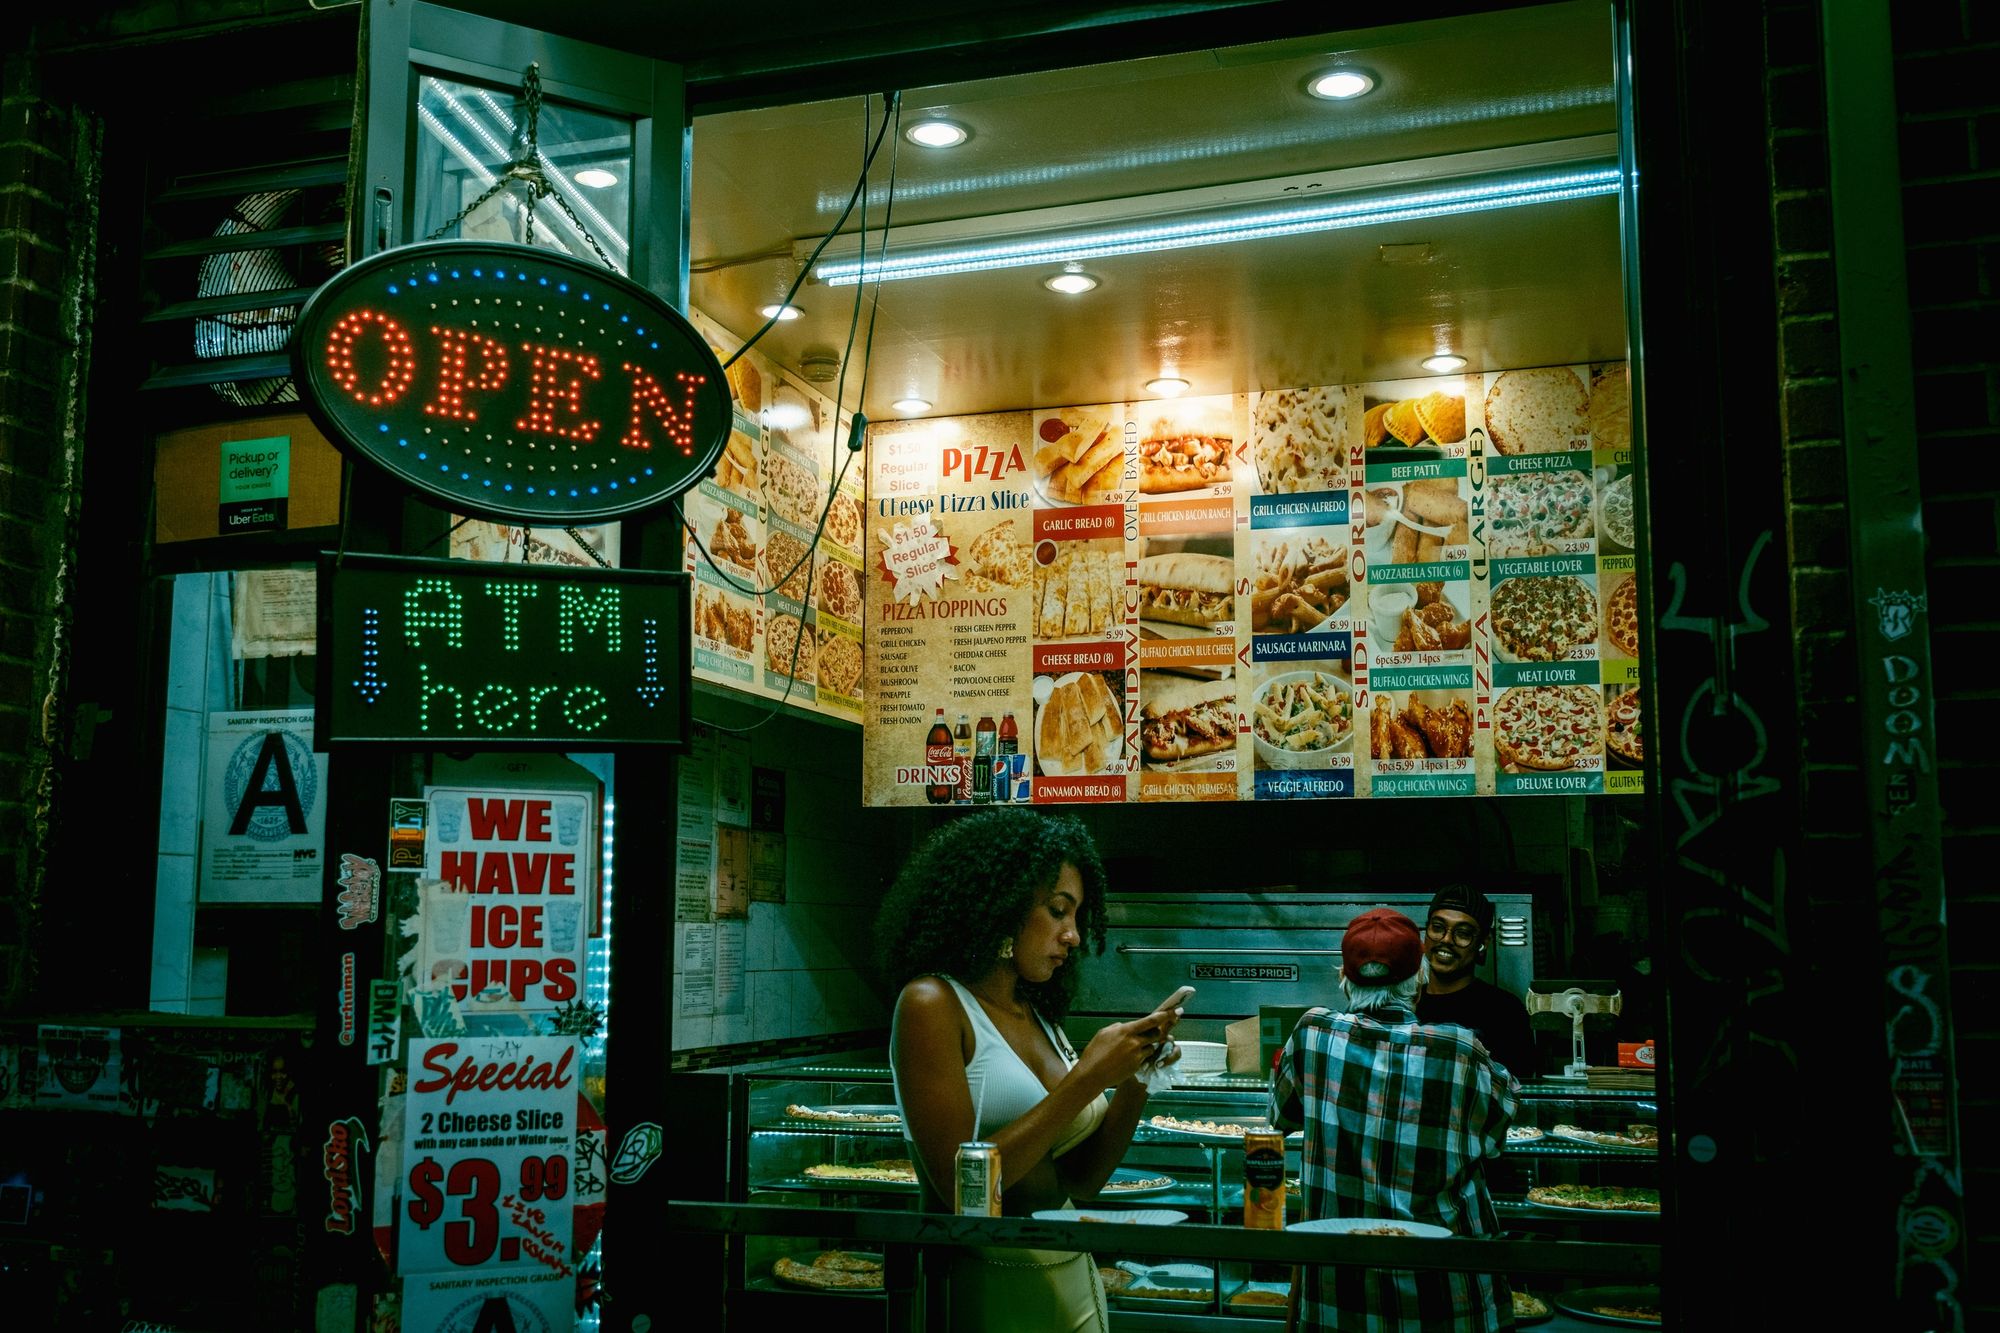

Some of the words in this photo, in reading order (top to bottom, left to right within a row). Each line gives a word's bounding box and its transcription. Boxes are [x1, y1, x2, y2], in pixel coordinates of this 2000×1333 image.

[326, 309, 706, 456] OPEN
[1125, 421, 1137, 480] BAKED
[1448, 448, 1464, 457] 1.99
[230, 451, 265, 466] Pickup
[268, 451, 280, 461] or
[1509, 457, 1543, 470] CHEESE
[1545, 456, 1573, 467] PIZZA
[230, 464, 278, 480] delivery?
[881, 463, 928, 476] Regular
[1392, 466, 1411, 478] BEEF
[1414, 464, 1441, 476] PATTY
[890, 480, 920, 491] Slice
[1327, 478, 1346, 488] 6.99
[1105, 493, 1123, 502] 4.99
[1214, 486, 1231, 496] 5.99
[940, 493, 985, 513] Pizza
[991, 490, 1029, 510] Slice
[1253, 504, 1274, 516] GRILL
[1276, 503, 1309, 515] CHICKEN
[1311, 500, 1346, 513] ALFREDO
[229, 515, 250, 525] Uber
[252, 513, 274, 523] Eats
[1125, 490, 1138, 542] OVEN
[1140, 510, 1156, 523] GRILL
[1157, 509, 1184, 521] CHICKEN
[1185, 508, 1208, 520] BACON
[1209, 507, 1231, 519] RANCH
[1351, 444, 1365, 582] ORDER
[1043, 519, 1073, 531] GARLIC
[1075, 517, 1102, 529] BREAD
[1105, 517, 1115, 528] (8)
[896, 525, 928, 545] $1.50
[892, 541, 940, 564] Regular
[1565, 543, 1590, 552] 23.99
[1448, 550, 1466, 560] 4.99
[905, 561, 937, 579] Slice
[1371, 567, 1426, 579] MOZZARELLA
[1428, 566, 1451, 577] STICK
[1453, 565, 1463, 577] (6)
[1498, 561, 1550, 575] VEGETABLE
[1552, 560, 1582, 572] LOVER
[404, 578, 621, 653] ATM
[882, 600, 926, 621] PIZZA
[929, 598, 1007, 618] TOPPINGS
[880, 627, 913, 635] PEPPERONI
[1216, 625, 1233, 636] 5.99
[1330, 620, 1348, 630] 6.99
[1106, 629, 1124, 639] 5.99
[880, 640, 897, 648] GRILL
[899, 639, 926, 647] CHICKEN
[954, 638, 972, 646] FRESH
[973, 637, 1004, 646] JALAPENO
[1006, 636, 1027, 644] PEPPER
[1256, 642, 1297, 655] SAUSAGE
[1298, 640, 1346, 653] MARINARA
[880, 653, 907, 661] SAUSAGE
[954, 651, 984, 659] CHEDDAR
[985, 650, 1007, 658] CHEESE
[1141, 647, 1167, 658] BUFFALO
[1168, 646, 1194, 657] CHICKEN
[1196, 645, 1210, 656] BLUE
[1211, 644, 1233, 655] CHEESE
[1570, 649, 1595, 659] 23.99
[1042, 654, 1072, 666] CHEESE
[1074, 653, 1101, 664] BREAD
[1103, 652, 1114, 665] (8)
[1354, 620, 1368, 708] SIDE
[1418, 654, 1440, 663] 14pcs
[901, 665, 918, 673] OLIVE
[954, 664, 976, 672] BACON
[1126, 562, 1139, 772] SANDWICH
[1475, 612, 1490, 729] PIZZA
[880, 678, 918, 686] MUSHROOM
[954, 677, 992, 685] PROVOLONE
[1373, 675, 1406, 687] BUFFALO
[1408, 674, 1442, 686] CHICKEN
[1443, 673, 1469, 685] WINGS
[1517, 670, 1544, 682] MEAT
[1545, 669, 1576, 681] LOVER
[418, 663, 607, 732] here
[880, 691, 911, 699] PINEAPPLE
[954, 690, 986, 698] PARMESAN
[987, 689, 1009, 697] CHEESE
[880, 704, 898, 712] FRESH
[227, 717, 257, 725] SANITARY
[259, 716, 296, 725] INSPECTION
[880, 717, 898, 725] FRESH
[507, 762, 528, 773] GET
[1216, 760, 1234, 770] 5.99
[1331, 756, 1350, 766] 6.99
[1574, 759, 1599, 768] 23.99
[1105, 763, 1124, 773] 4.99
[897, 767, 959, 783] DRINKS
[228, 732, 309, 834] A
[1143, 785, 1162, 795] GRILL
[1164, 784, 1196, 794] CHICKEN
[1197, 782, 1235, 794] PARMESAN
[1268, 781, 1301, 793] VEGGIE
[1302, 780, 1344, 792] ALFREDO
[1378, 780, 1397, 792] BBQ
[1398, 780, 1435, 791] CHICKEN
[1436, 778, 1467, 790] WINGS
[1516, 778, 1553, 790] DELUXE
[1555, 777, 1586, 789] LOVER
[1610, 776, 1636, 788] GLUTEN
[1038, 786, 1083, 797] CINNAMON
[1084, 786, 1110, 797] BREAD
[1111, 785, 1121, 797] (8)
[468, 798, 552, 841] WE
[293, 850, 316, 858] NYC
[441, 851, 575, 894] HAVE
[470, 905, 543, 948] ICE
[1214, 968, 1258, 977] BAKERS
[1260, 969, 1290, 977] PRIDE
[339, 954, 354, 1044] @urhuman
[415, 1043, 574, 1105] Special
[421, 1113, 433, 1134] 2
[438, 1110, 512, 1134] Cheese
[516, 1110, 563, 1130] Slice
[414, 1137, 436, 1150] with
[438, 1138, 456, 1150] any
[458, 1138, 478, 1148] can
[480, 1135, 504, 1147] soda
[507, 1136, 517, 1145] or
[518, 1134, 547, 1145] Water
[326, 1122, 350, 1232] LordSko
[408, 1156, 568, 1266] $3.99
[430, 1279, 474, 1290] SANITARY
[475, 1276, 528, 1287] INSPECTION
[530, 1273, 560, 1284] GRADE
